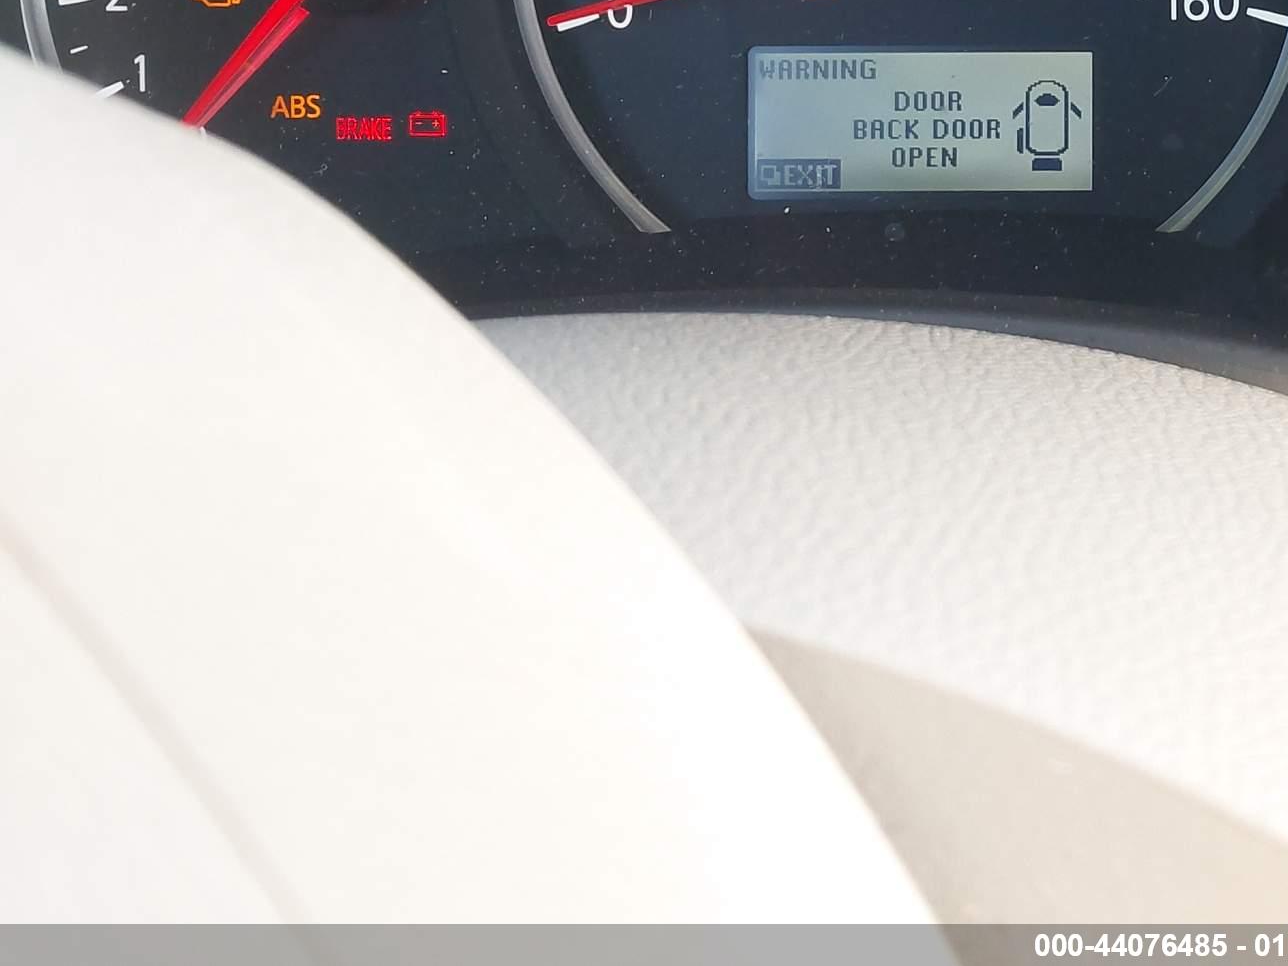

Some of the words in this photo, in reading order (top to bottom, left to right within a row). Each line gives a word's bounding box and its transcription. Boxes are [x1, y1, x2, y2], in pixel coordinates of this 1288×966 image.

[133, 54, 146, 93] 1
[759, 59, 877, 80] WARNING
[271, 94, 321, 119] ABS
[894, 91, 963, 112] DOOR
[335, 117, 392, 140] BRAKE
[853, 119, 919, 139] BACK
[932, 119, 1001, 139] DOOR
[892, 146, 958, 167] OPEN
[783, 163, 838, 186] EXIT
